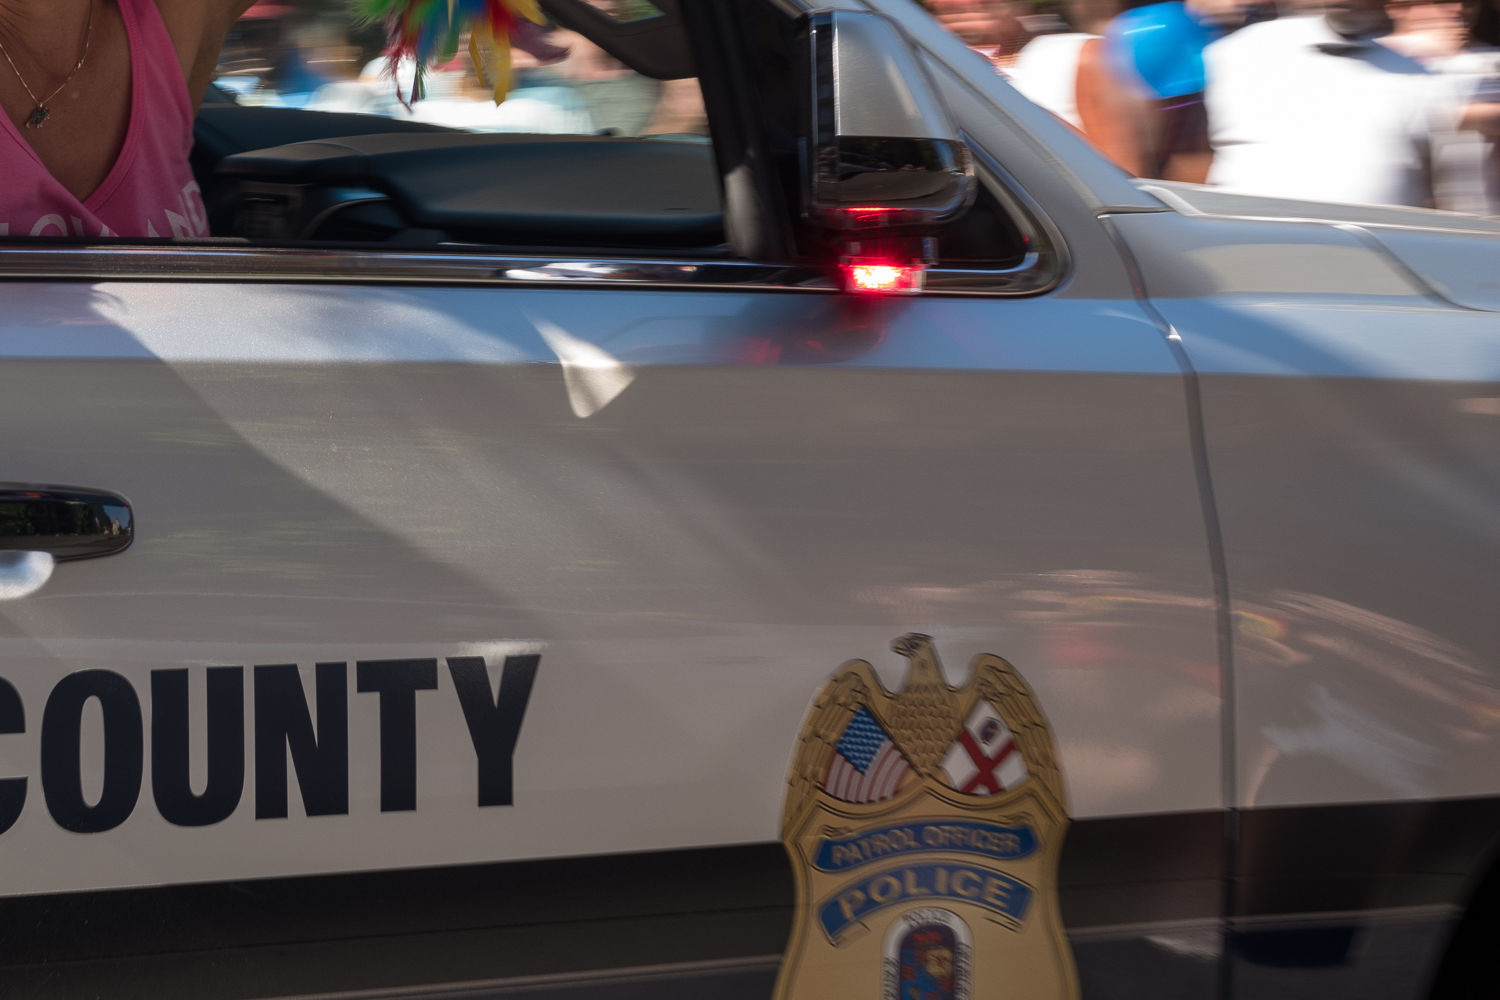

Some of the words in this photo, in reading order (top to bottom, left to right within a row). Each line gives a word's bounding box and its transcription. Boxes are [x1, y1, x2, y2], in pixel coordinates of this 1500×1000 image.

[831, 827, 921, 867] PATROL
[921, 825, 1021, 855] OFFICER
[836, 867, 1015, 921] POLICE
